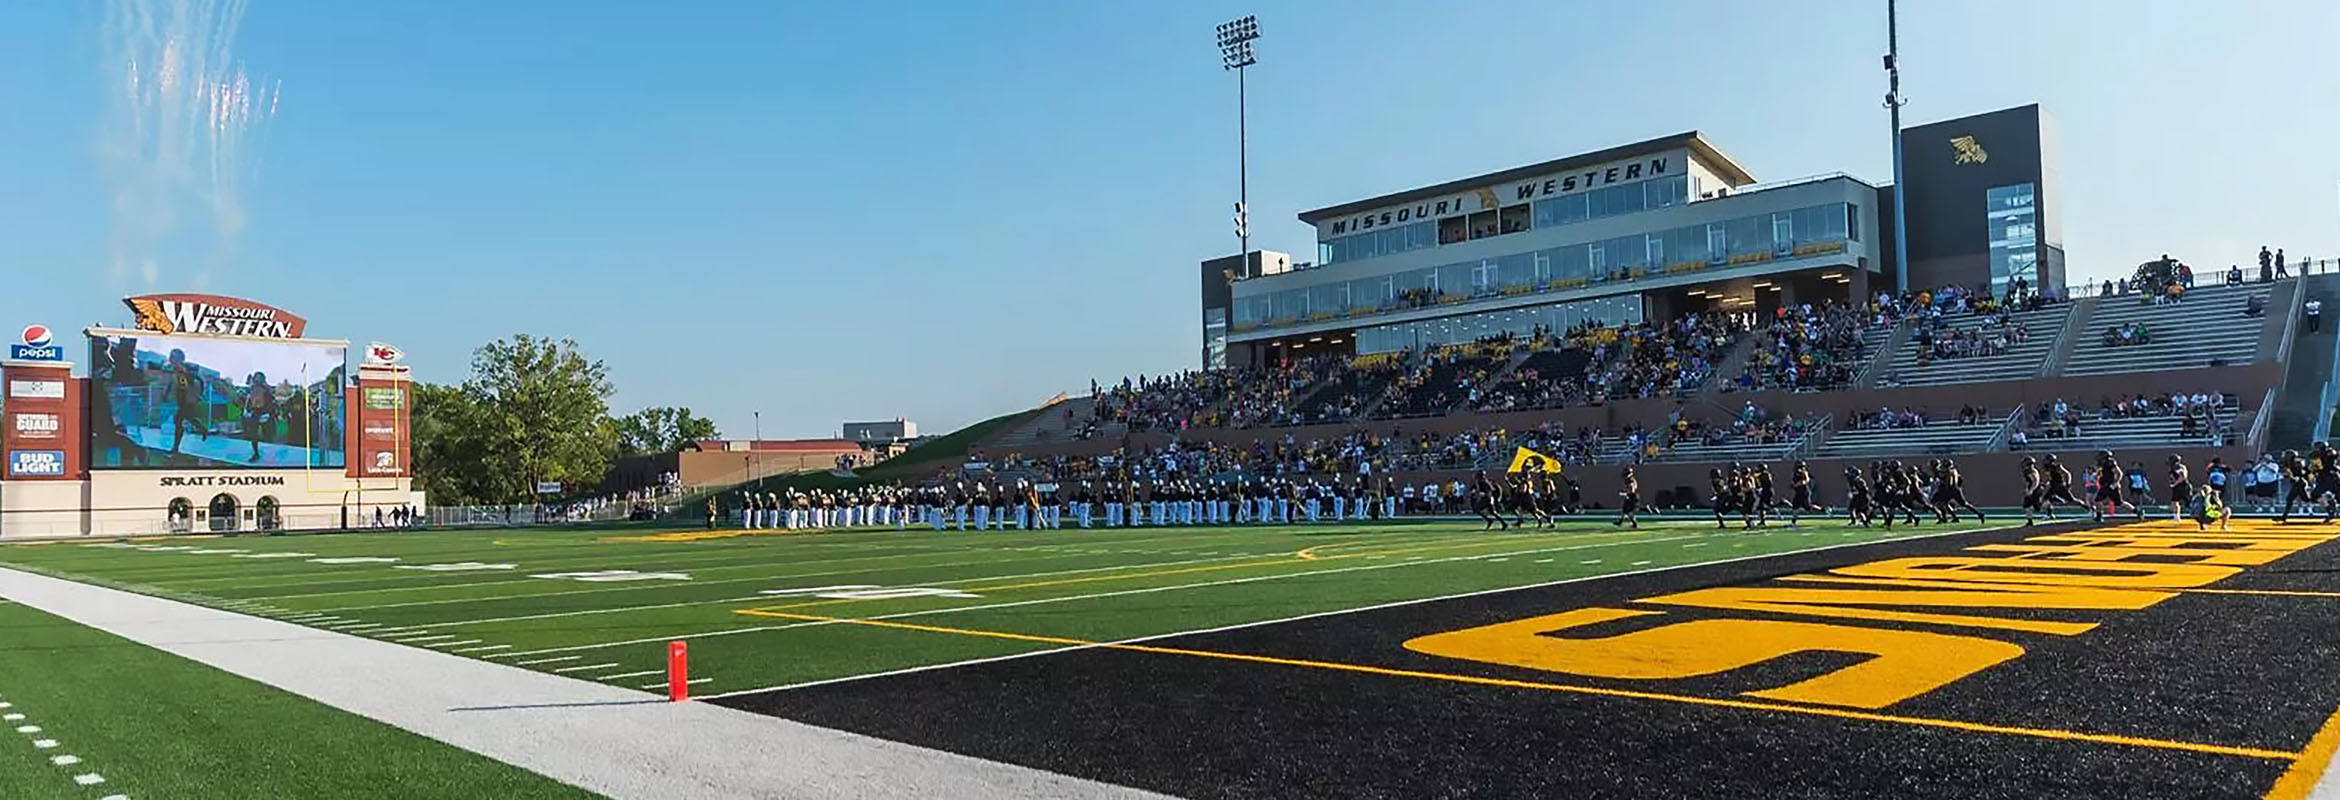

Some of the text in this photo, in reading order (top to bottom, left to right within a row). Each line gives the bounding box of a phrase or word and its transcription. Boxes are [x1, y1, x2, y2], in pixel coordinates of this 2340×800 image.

[1517, 157, 1667, 200] WESTERN
[1331, 198, 1462, 236] MISSOURI
[205, 305, 277, 320] MISSOURI
[162, 300, 291, 338] WESTERN
[18, 348, 56, 359] pepsi
[19, 453, 55, 463] BUD
[13, 462, 61, 473] LIGHT
[160, 476, 216, 487] SPRATT
[218, 475, 285, 486] STADIUM
